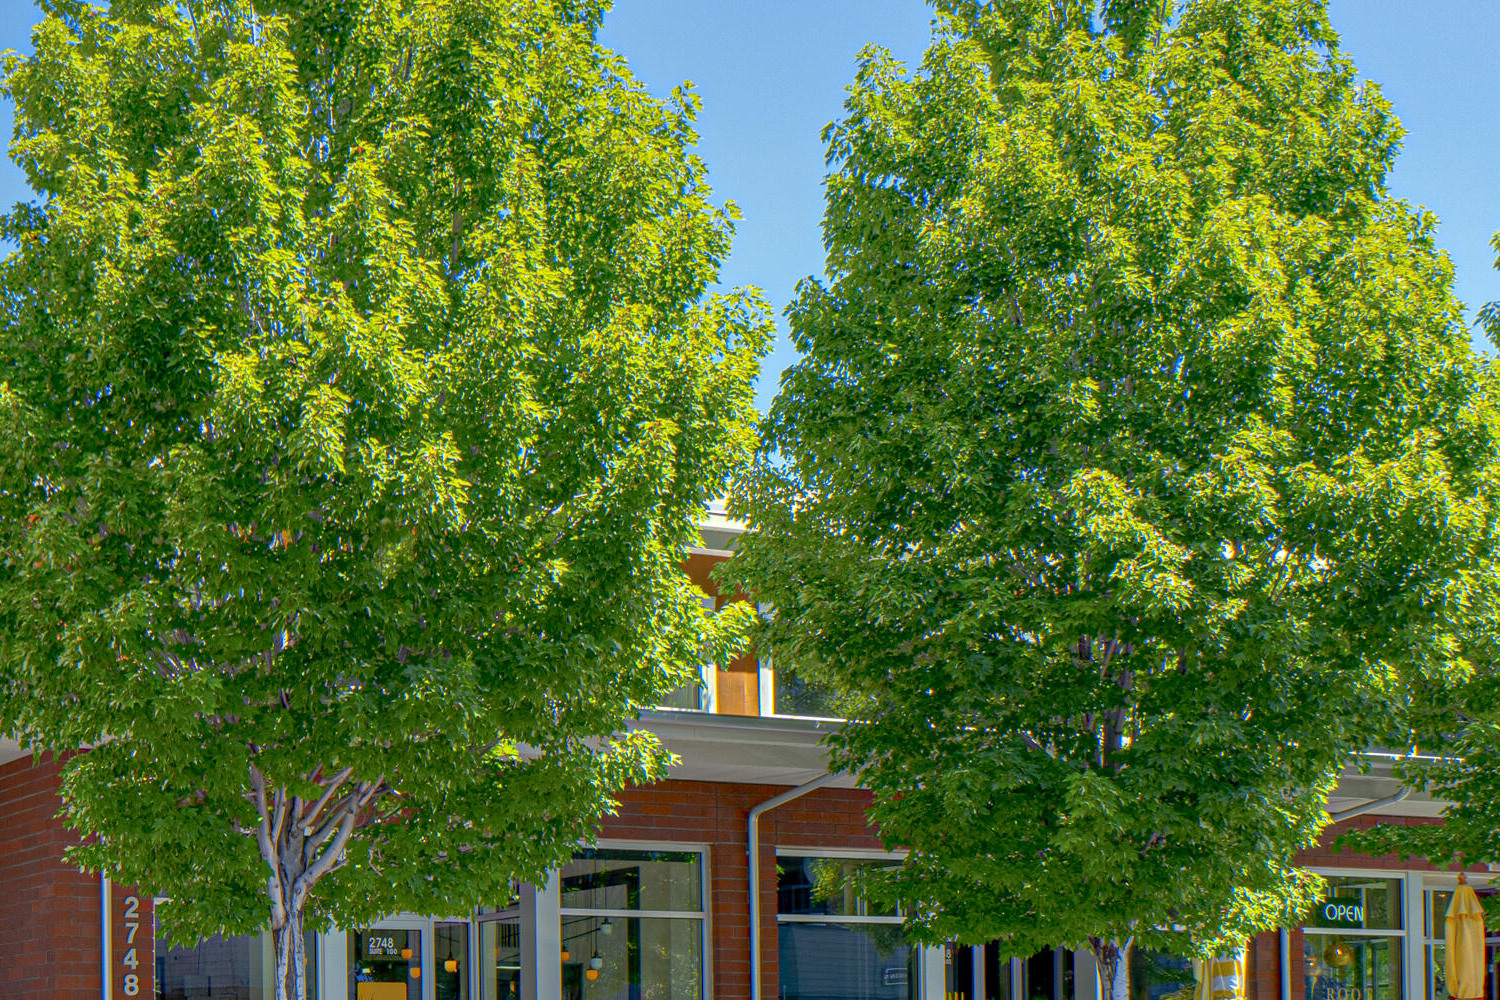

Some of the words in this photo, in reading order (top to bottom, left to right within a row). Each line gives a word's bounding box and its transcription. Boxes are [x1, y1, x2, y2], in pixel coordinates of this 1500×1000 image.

[1324, 903, 1364, 922] OPEN
[123, 896, 140, 996] 2748
[368, 937, 394, 948] 2748
[1326, 987, 1374, 1000] ROOT
